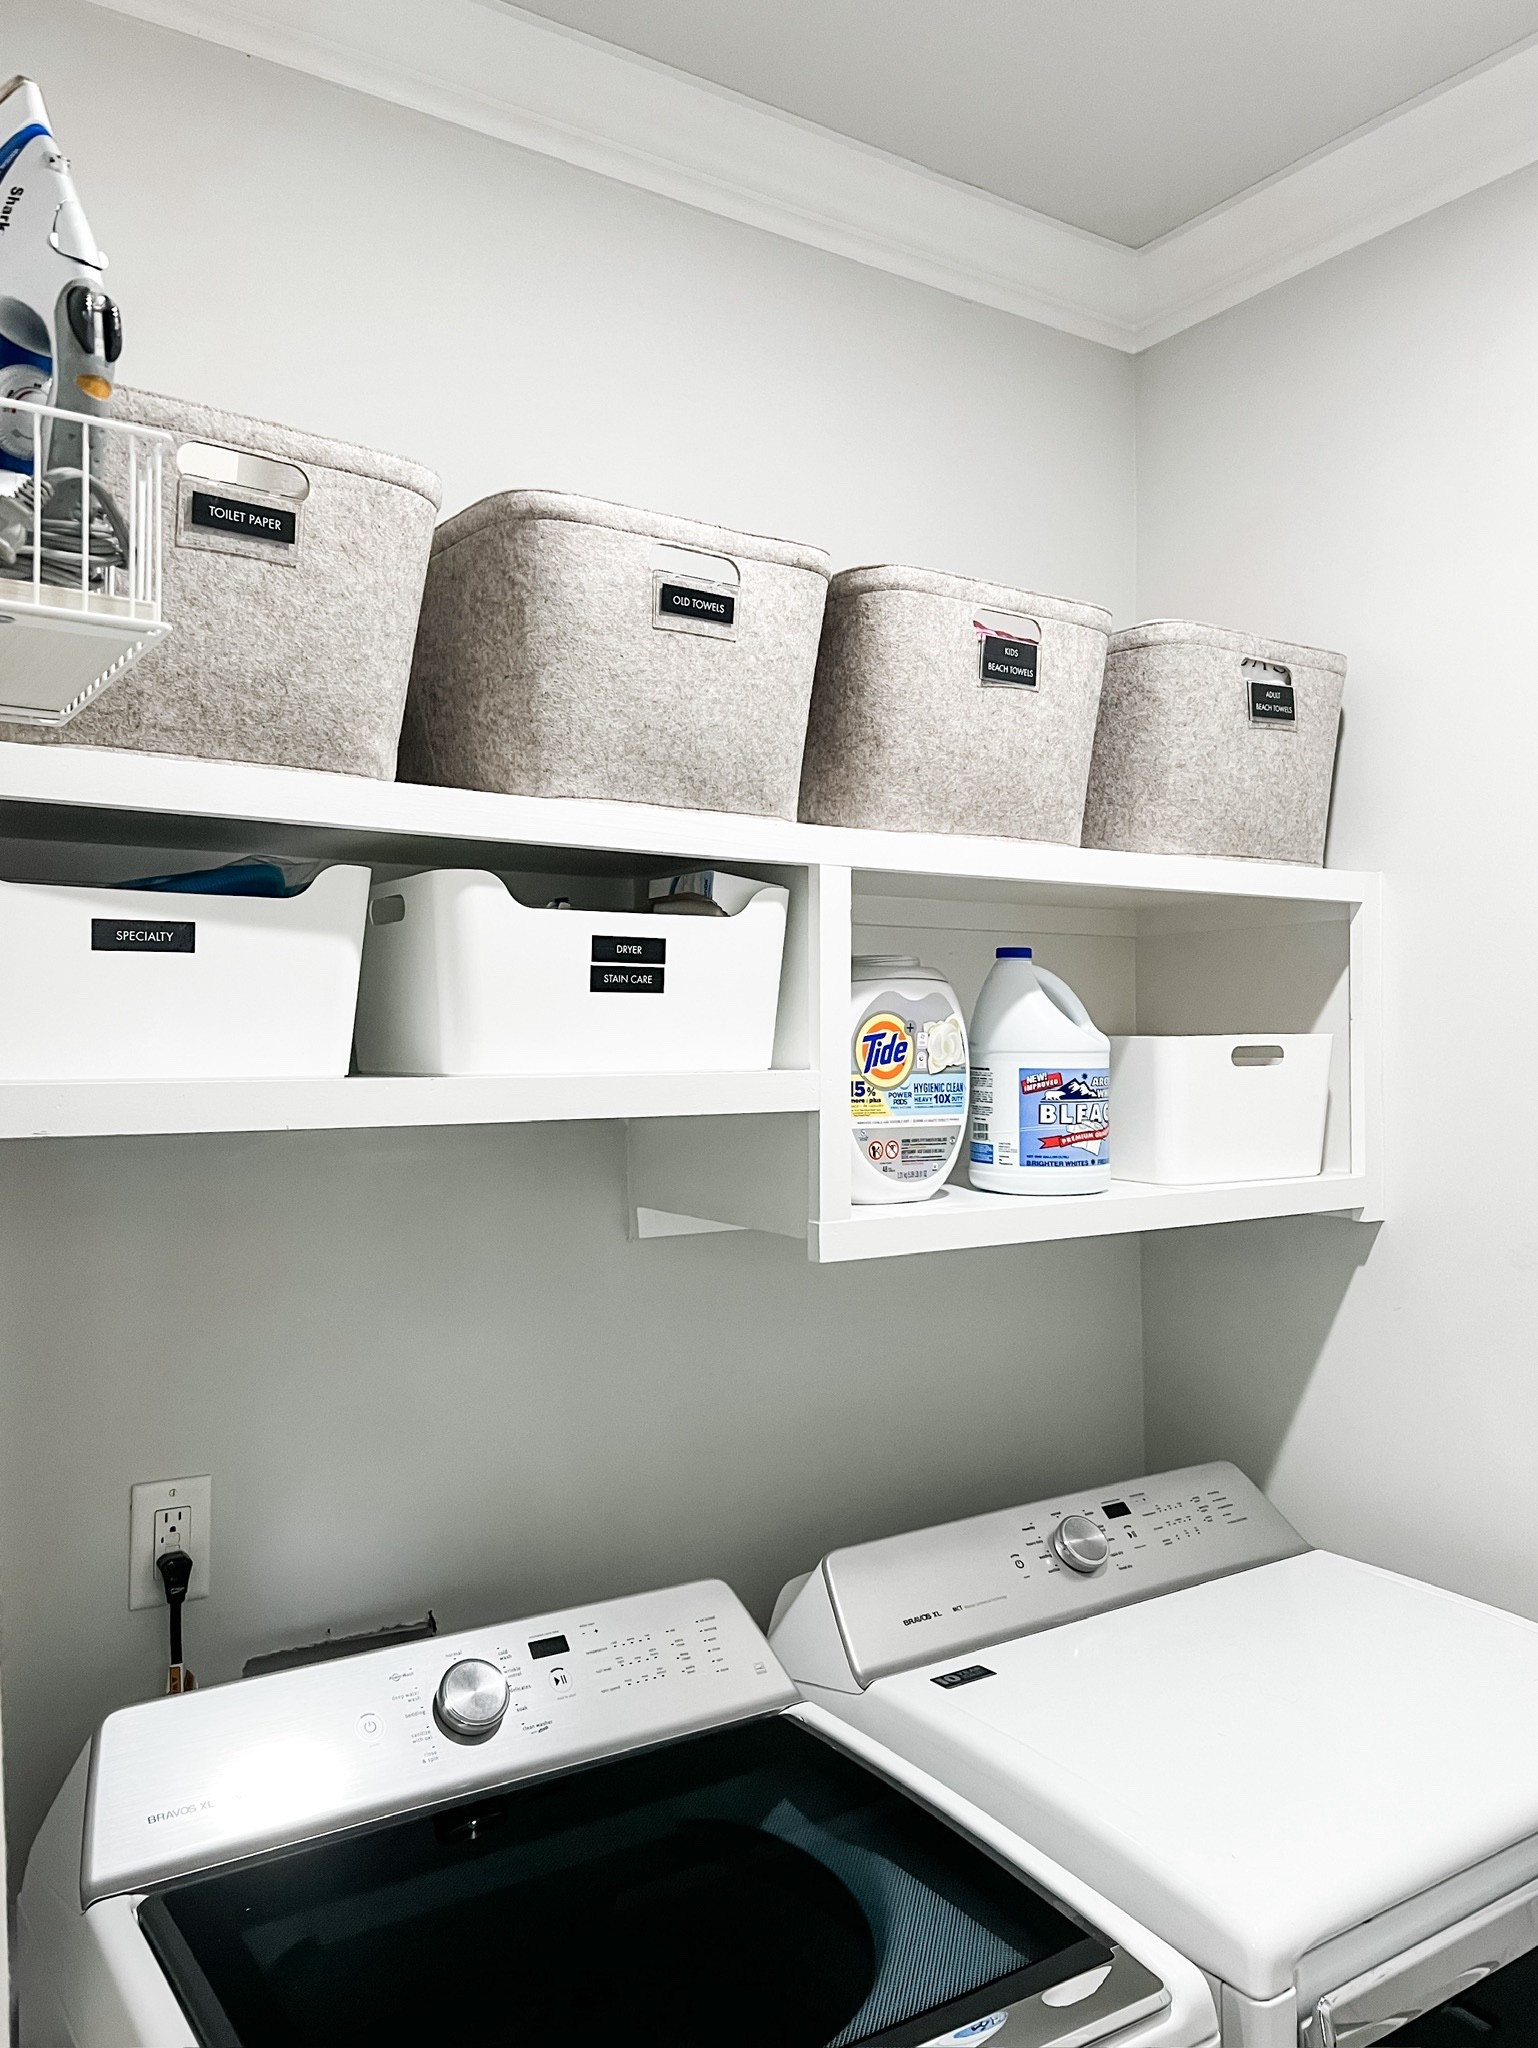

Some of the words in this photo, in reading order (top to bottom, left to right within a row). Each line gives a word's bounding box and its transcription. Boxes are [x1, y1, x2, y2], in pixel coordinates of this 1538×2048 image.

[0, 186, 24, 232] Shark
[208, 505, 247, 523] TOILET
[248, 513, 282, 531] PAPER
[672, 595, 691, 607] OLD
[692, 598, 725, 613] TOWELS
[1004, 647, 1019, 657] KIDS
[987, 662, 1009, 673] BEACH
[1009, 666, 1034, 678] TOWELS
[1265, 690, 1281, 699] ADULT
[1255, 702, 1272, 711] BEACH
[1272, 704, 1293, 714] TOWELS
[115, 930, 174, 942] SPECIALTY
[616, 944, 643, 955] DRYER
[603, 974, 629, 983] STAIN
[630, 974, 653, 984] CARE
[862, 1032, 908, 1074] Tide
[1026, 1072, 1048, 1084] NEW!
[913, 1082, 945, 1093] HYGIENIC
[945, 1082, 964, 1092] CLEAN
[1023, 1079, 1059, 1093] IMPROVED
[888, 1091, 912, 1099] POWER
[933, 1093, 951, 1104] 10X
[1061, 1132, 1094, 1145] PREMIUM
[1064, 1159, 1089, 1167] WHITES
[902, 1613, 932, 1627] BRAVOS
[147, 1804, 197, 1825] BRAVOS
[199, 1801, 215, 1812] XL
